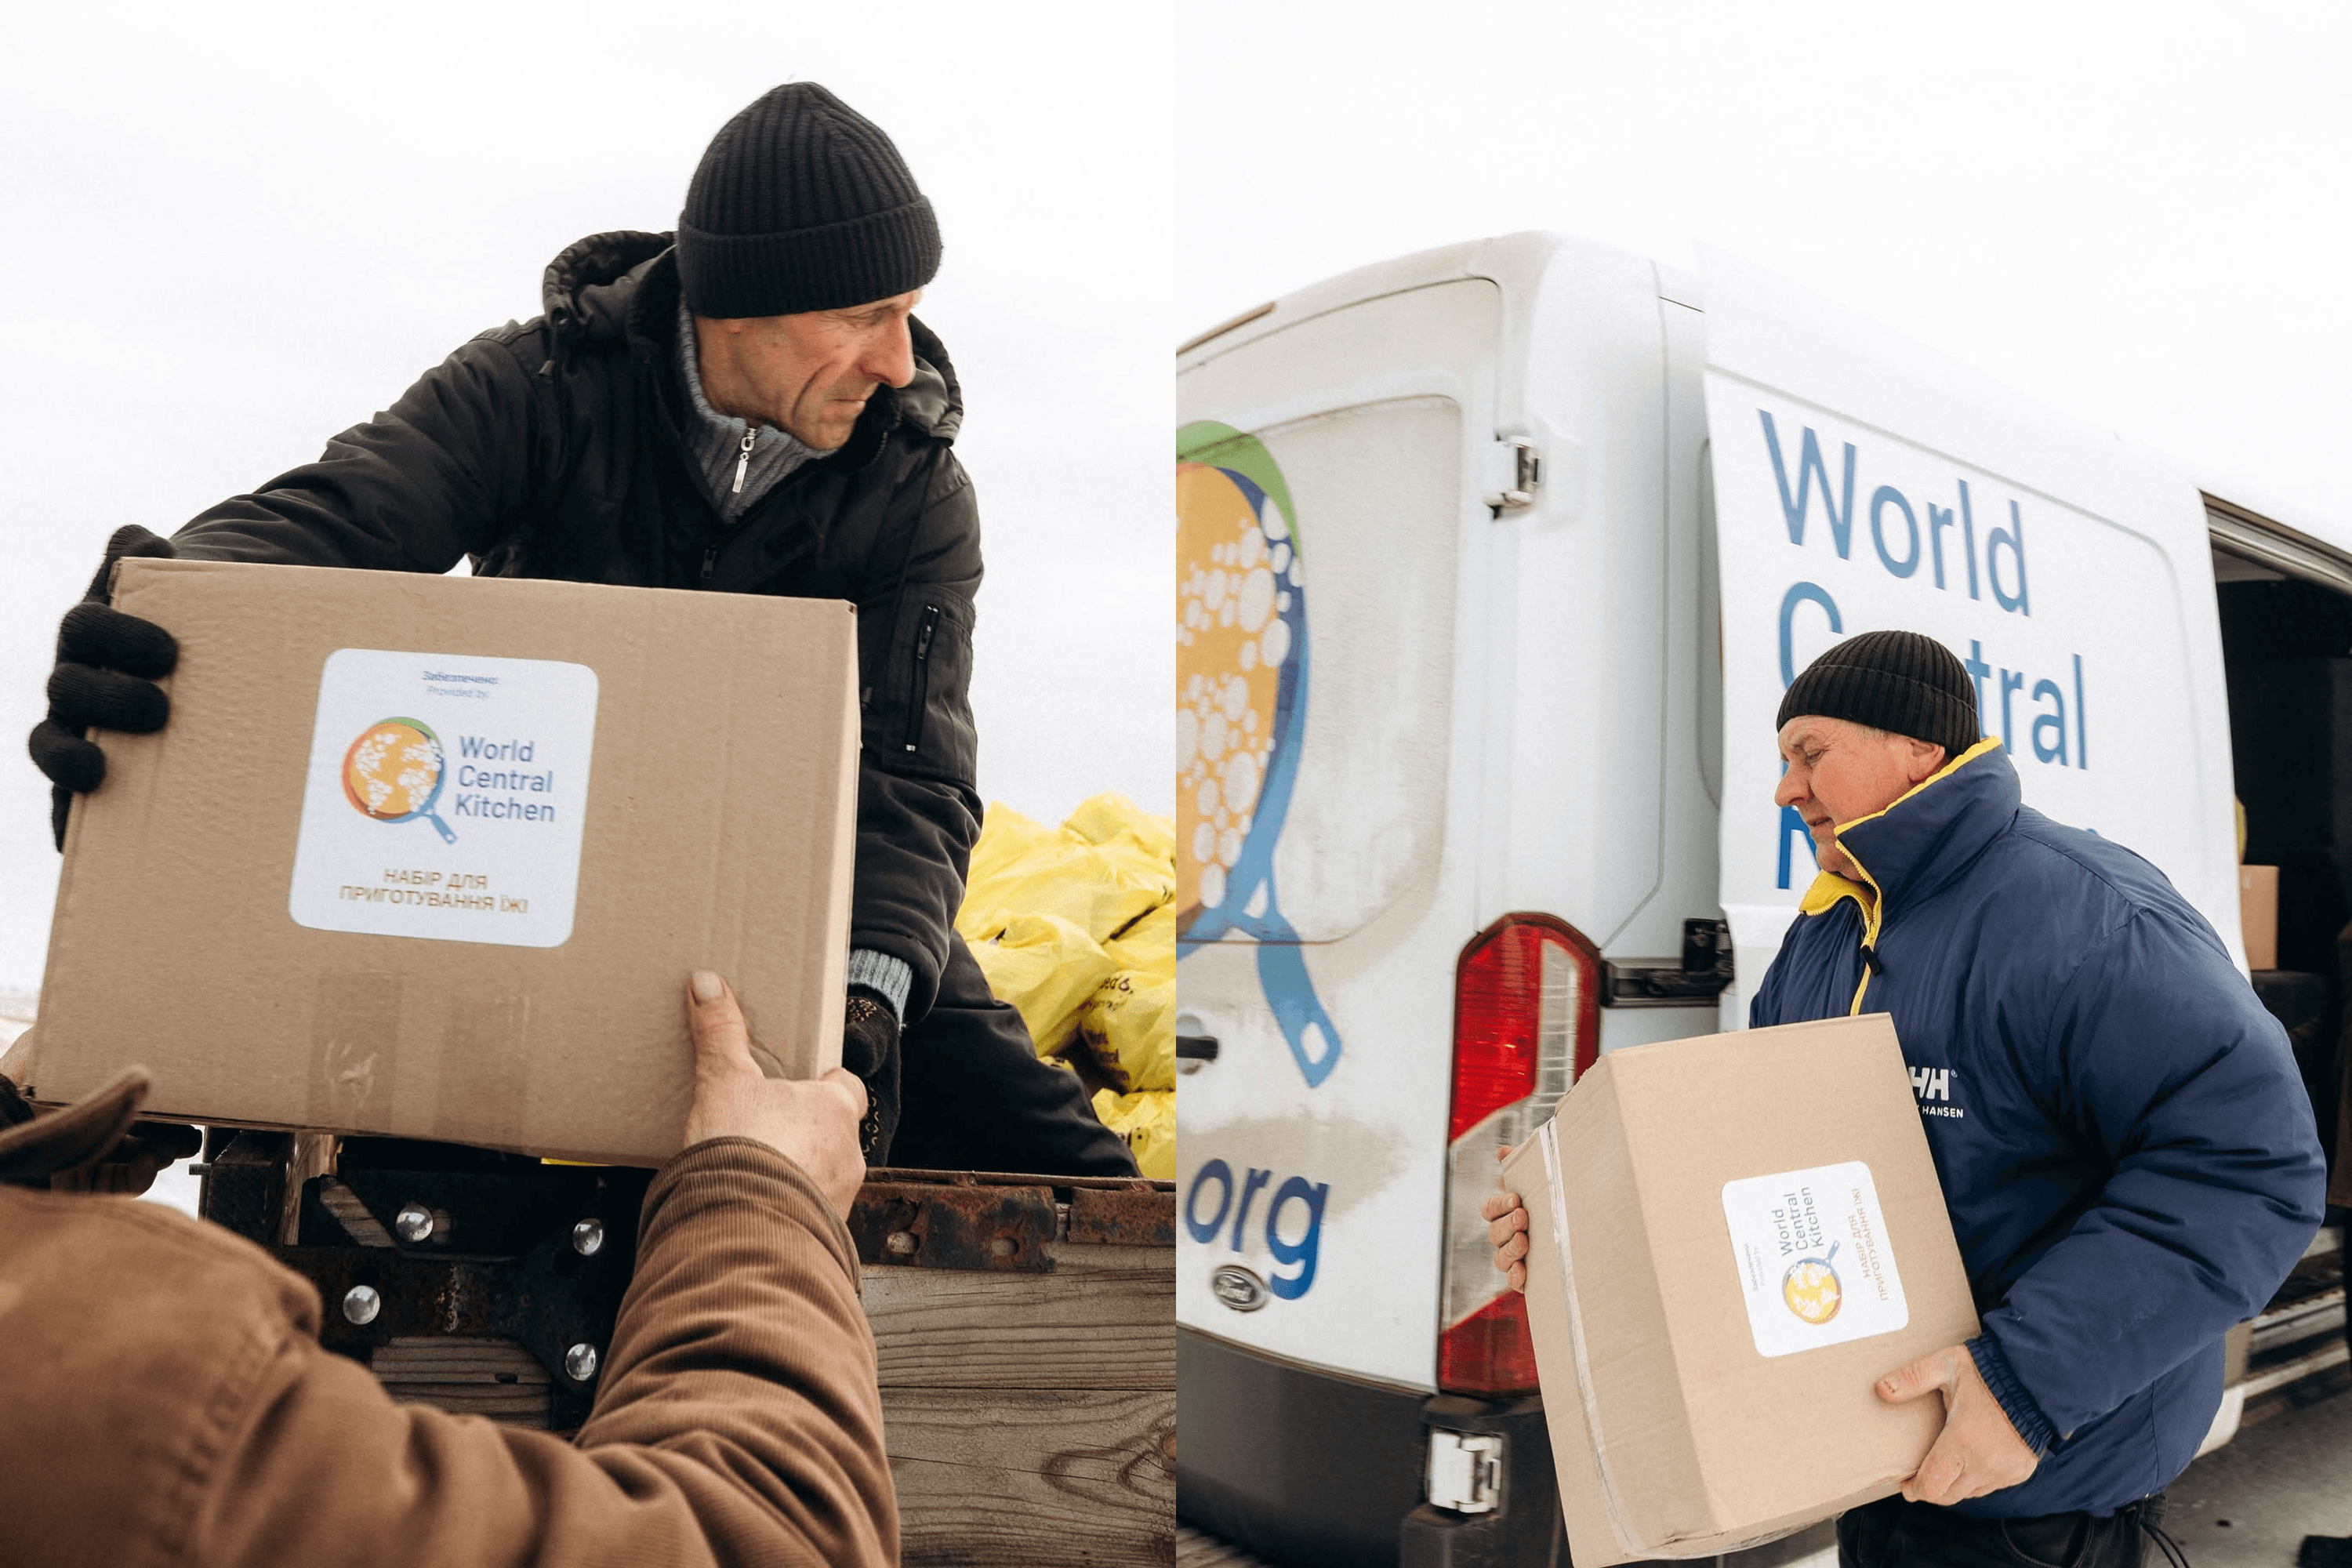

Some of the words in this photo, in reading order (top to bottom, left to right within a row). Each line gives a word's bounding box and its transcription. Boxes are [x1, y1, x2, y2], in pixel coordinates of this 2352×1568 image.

[1757, 408, 2030, 617] World
[1779, 581, 2089, 771] Ctral
[459, 735, 535, 762] World
[459, 764, 554, 793] Central
[455, 793, 554, 822] Kitchen
[339, 885, 495, 910] ПРИГОТУВАННЯ
[383, 868, 443, 886] НАБІР
[445, 873, 488, 890] ДЛЯ
[1922, 1105, 1963, 1118] HANSEN
[1185, 1158, 1330, 1301] org
[1772, 1209, 1793, 1256] World
[1784, 1192, 1808, 1250] Central
[1801, 1187, 1824, 1247] Kitchen
